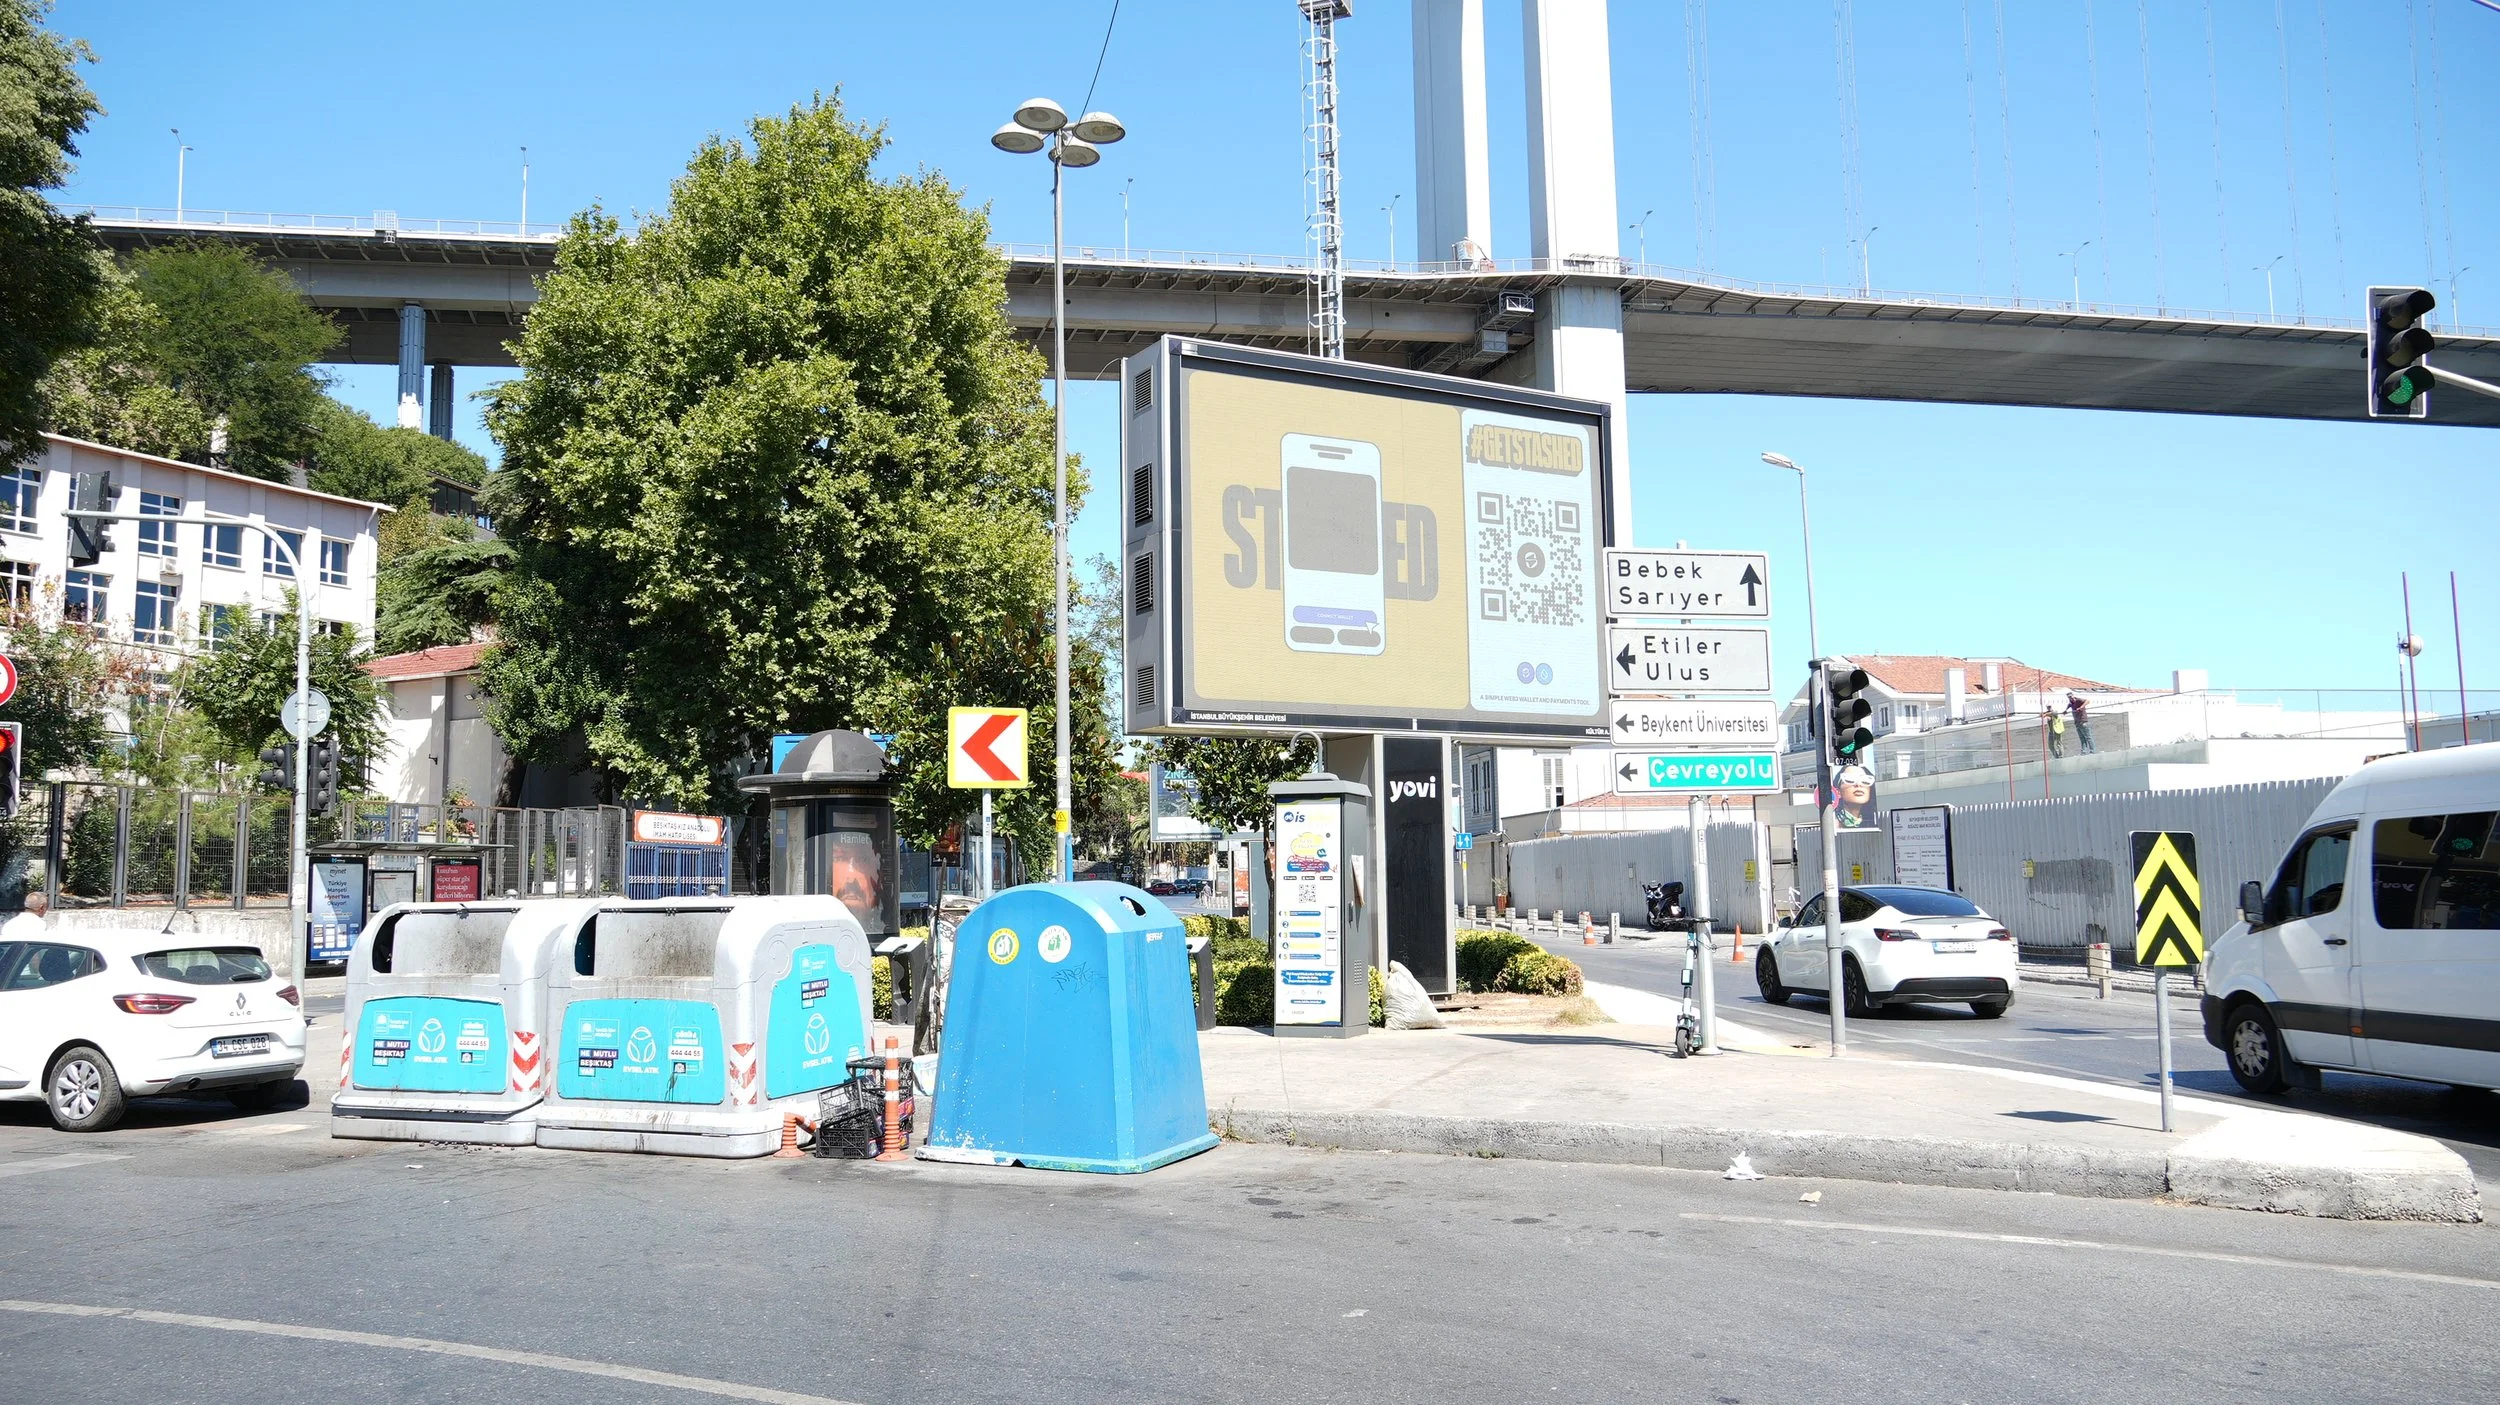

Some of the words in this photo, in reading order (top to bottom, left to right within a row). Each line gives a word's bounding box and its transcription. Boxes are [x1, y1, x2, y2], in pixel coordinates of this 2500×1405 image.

[1468, 424, 1582, 474] #GETSTASHED
[1618, 559, 1702, 579] Bebek
[1619, 586, 1723, 610] Sarıyer
[1644, 635, 1722, 655] Etiler
[1646, 662, 1710, 681] Ulus
[1190, 711, 1218, 720] İSTANBUL
[1218, 712, 1254, 721] BÜYÜKŞEHİR
[1254, 713, 1287, 722] BELEDİYESİ
[1641, 714, 1694, 737] Beykent
[1696, 710, 1769, 733] Üniversitesi
[1585, 727, 1604, 735] KÜLTÜR
[1835, 757, 1858, 766] 07-034
[1650, 759, 1772, 784] Çevreyolu
[1389, 775, 1436, 803] yovi
[840, 833, 871, 844] Hamlet
[329, 866, 347, 877] mynet
[328, 886, 347, 894] Manşeti
[811, 980, 828, 989] MUTLU
[217, 1040, 228, 1052] 34
[231, 1038, 248, 1051] CSC
[250, 1036, 267, 1049] 028
[593, 1050, 617, 1058] MUTLU
